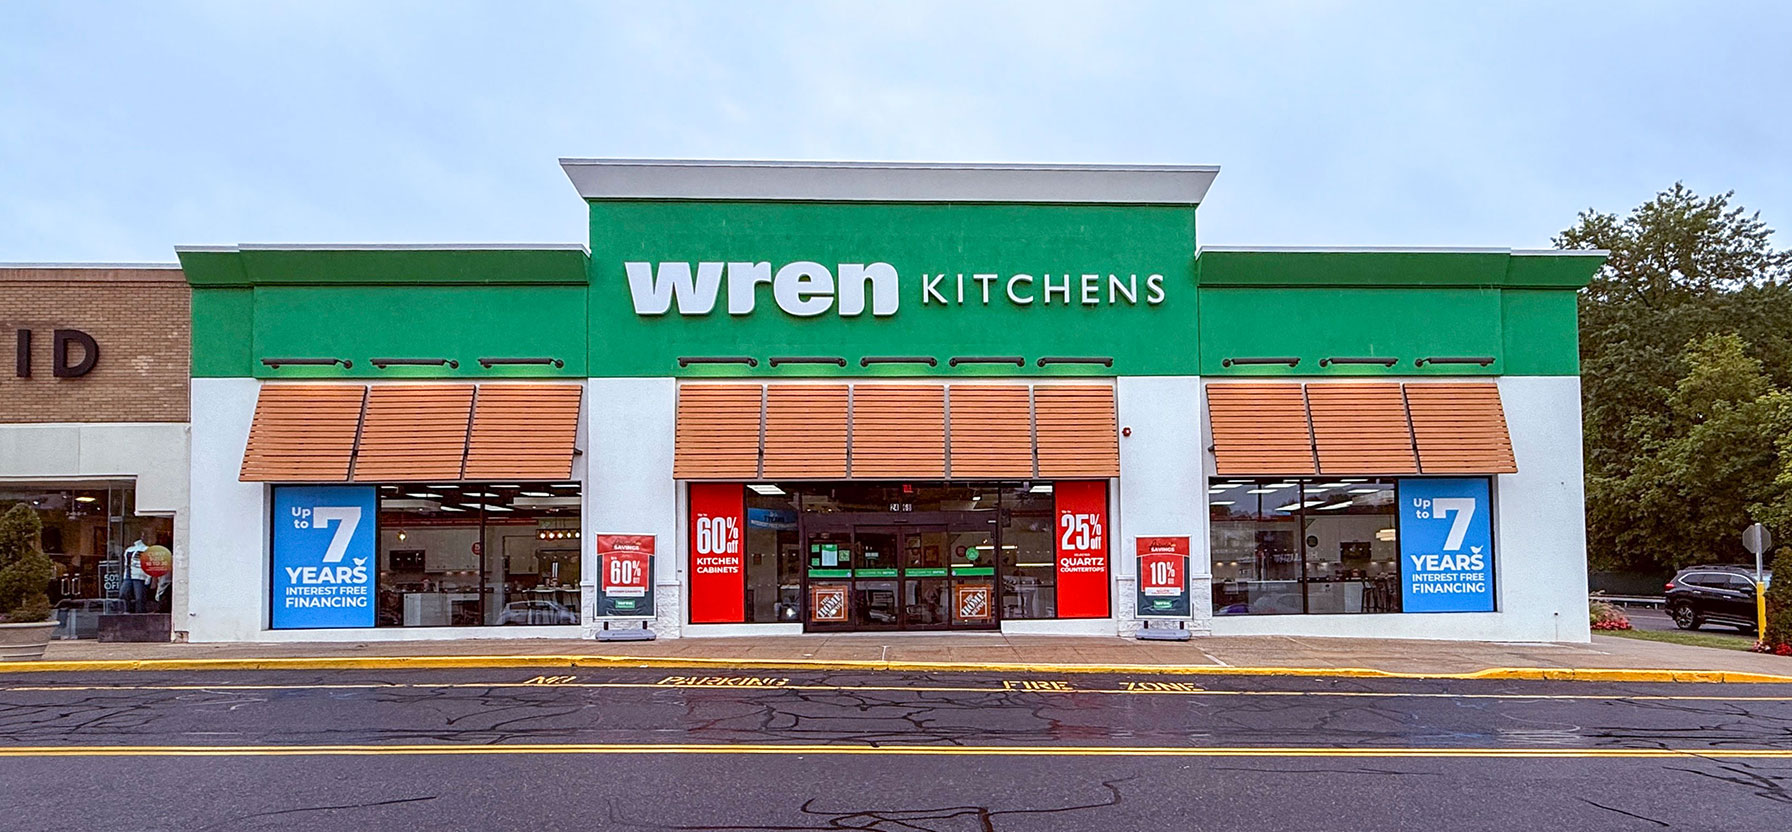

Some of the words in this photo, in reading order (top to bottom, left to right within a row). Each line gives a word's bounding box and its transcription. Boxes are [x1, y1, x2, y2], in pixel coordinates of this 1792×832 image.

[624, 261, 899, 316] wren
[921, 272, 1167, 305] KITCHENS
[1413, 498, 1431, 509] Up
[291, 506, 311, 519] Up
[1416, 510, 1430, 519] to
[293, 519, 309, 529] to
[1432, 498, 1476, 551] 7
[313, 506, 362, 563] 7
[696, 516, 739, 554] 60%
[1061, 513, 1102, 550] 25%
[727, 539, 739, 554] off
[1090, 535, 1102, 550] off
[696, 557, 739, 565] KITCHEN
[1060, 557, 1105, 568] QUARTZ
[1410, 553, 1485, 571] YEARS
[285, 566, 368, 585] YEARS
[610, 560, 641, 585] 60%
[1150, 561, 1176, 585] 10%
[1412, 573, 1459, 582] INTEREST
[1460, 573, 1485, 581] FREE
[285, 586, 337, 596] INTEREST
[339, 586, 368, 595] FREE
[1412, 582, 1485, 594] FINANCING
[285, 596, 368, 608] FINANCING
[657, 676, 790, 686] PARKING
[1002, 680, 1074, 690] FIRE
[1118, 682, 1204, 691] ZONE
